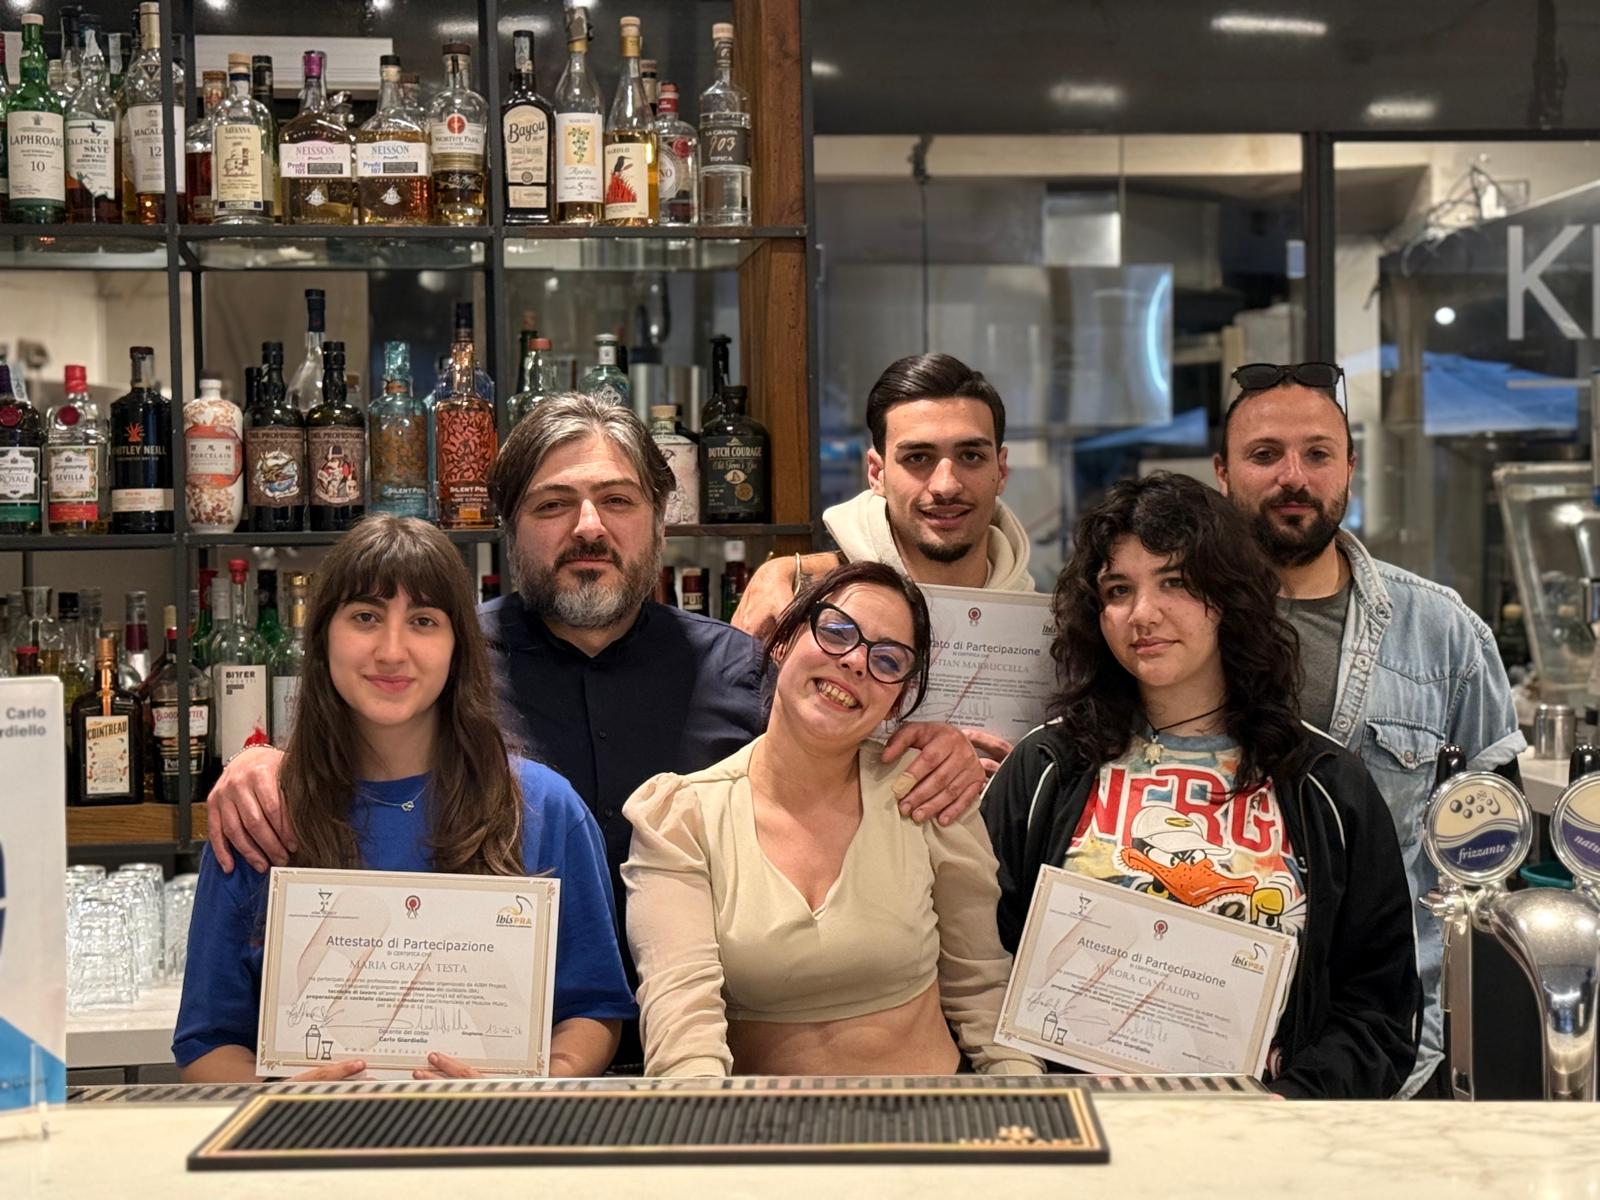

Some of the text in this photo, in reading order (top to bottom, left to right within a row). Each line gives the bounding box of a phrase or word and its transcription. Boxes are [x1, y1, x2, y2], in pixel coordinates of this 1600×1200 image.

[134, 128, 177, 137] MACAL
[507, 121, 545, 144] Bayou
[9, 135, 64, 148] LAPHROAIG
[65, 138, 109, 146] TALISKER
[83, 146, 108, 154] SKYE
[149, 146, 162, 158] 12
[296, 146, 335, 155] NEISSON
[371, 145, 410, 154] NEISSON
[31, 160, 46, 173] 10
[577, 181, 583, 192] 5
[143, 445, 167, 455] NEILL
[708, 447, 762, 457] DUTCH COURAGE
[0, 463, 33, 474] anqueray
[55, 473, 85, 481] SEVILLA
[953, 640, 963, 650] di
[966, 641, 1041, 658] Partecipazione
[226, 671, 256, 679] BITTER
[6, 706, 46, 720] Carlo
[0, 724, 46, 738] rdiello
[87, 721, 128, 740] COINTREAU
[1456, 844, 1507, 864] frizzante
[326, 935, 495, 953] Attestato di Partecipazione
[350, 959, 467, 973] MARIA GRAZIA TESTA
[1077, 936, 1227, 988] Attestato di Partecipazione
[1138, 976, 1201, 1002] CANTALUPO
